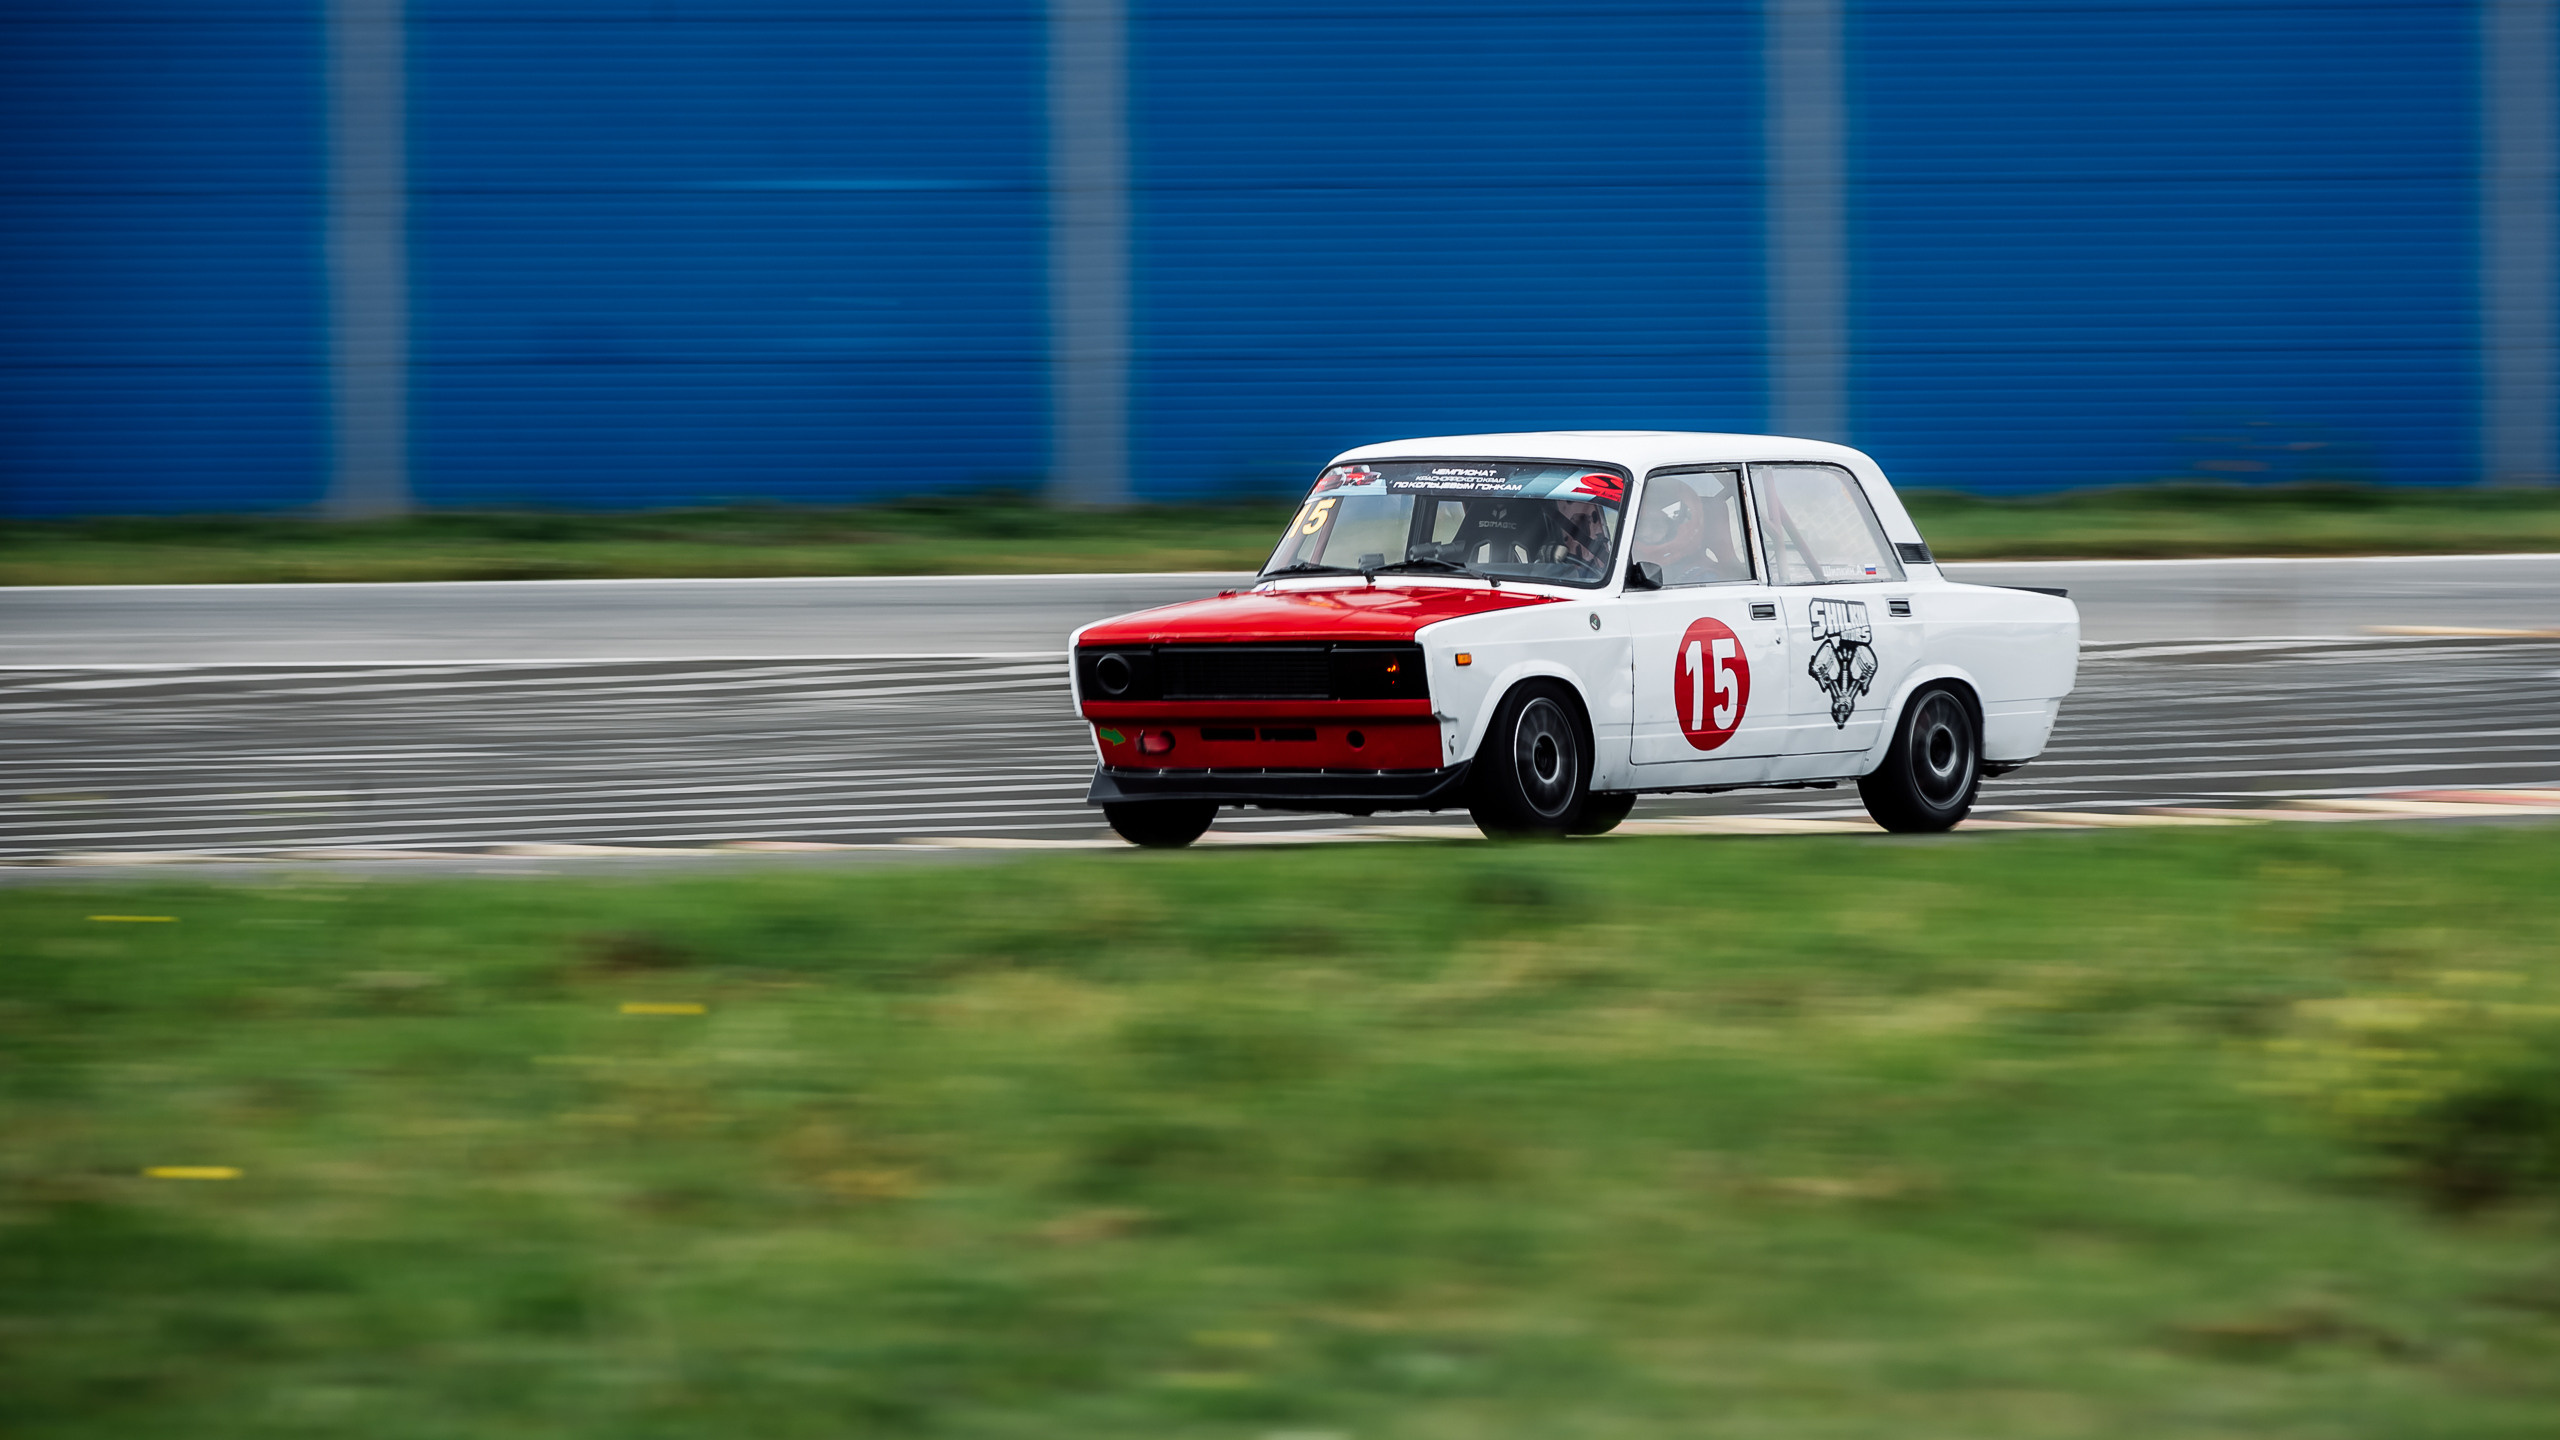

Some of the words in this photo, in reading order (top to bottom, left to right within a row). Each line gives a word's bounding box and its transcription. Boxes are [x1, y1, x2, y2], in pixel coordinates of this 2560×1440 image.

[1431, 468, 1498, 477] ЧЕМПИОНАТ
[1392, 481, 1408, 489] ПО
[1407, 481, 1474, 490] КОЛЬЦЕВЫМ
[1475, 482, 1523, 491] ГОНКАМ
[1288, 498, 1337, 539] 15
[1685, 638, 1739, 731] 15
